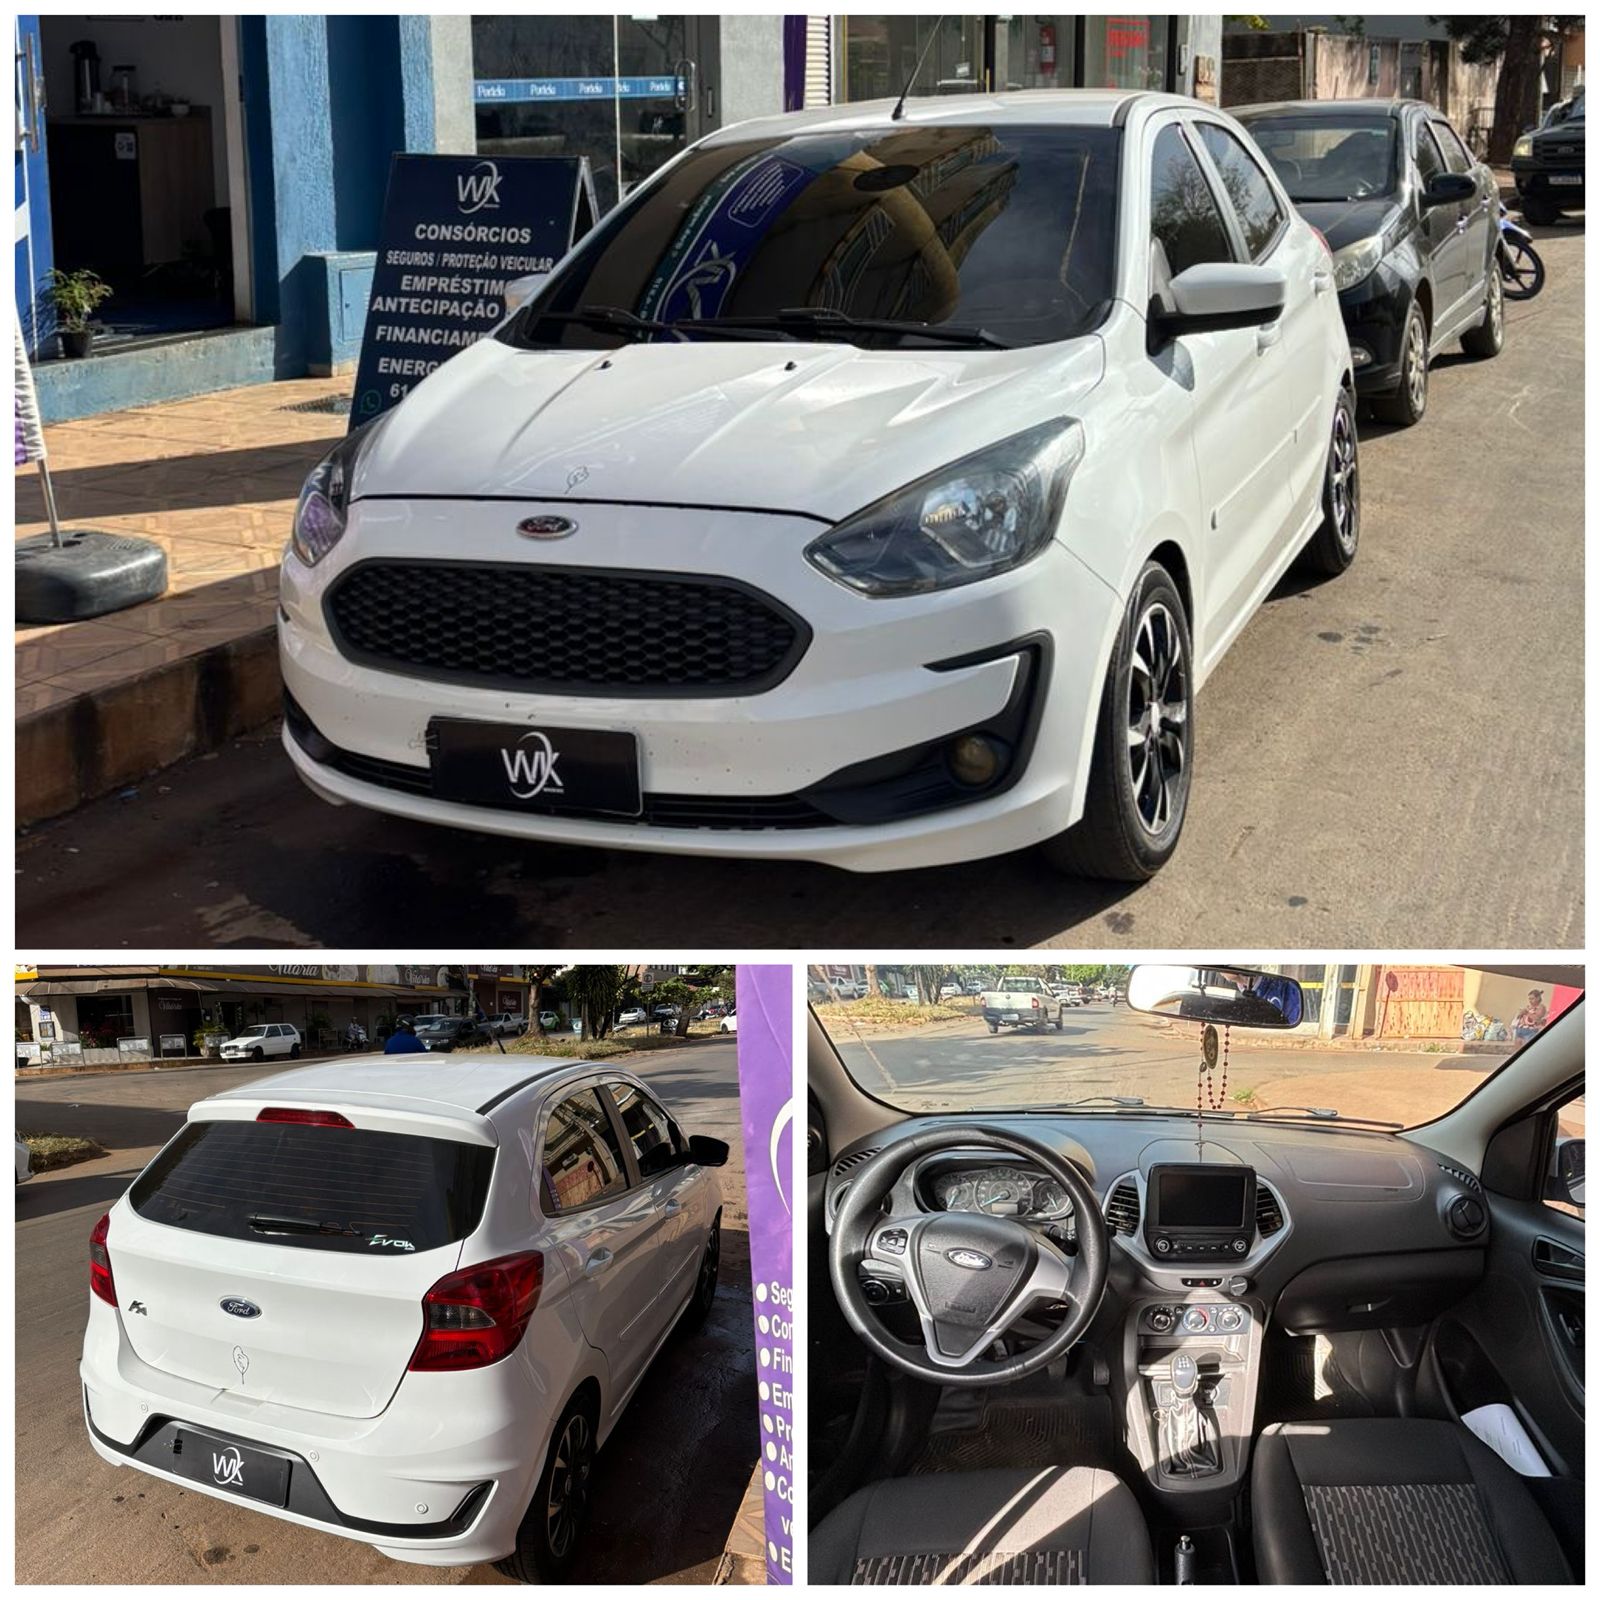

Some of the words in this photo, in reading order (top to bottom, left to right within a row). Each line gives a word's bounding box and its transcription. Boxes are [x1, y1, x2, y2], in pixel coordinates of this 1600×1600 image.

[414, 222, 532, 244] CONSÓRCIOS
[386, 250, 434, 267] SEGUROS
[442, 252, 498, 273] PROTEÇÃO
[500, 255, 554, 272] VEICULAR
[371, 296, 500, 321] ANTECIPAÇÃO
[227, 1302, 250, 1315] Ford
[776, 1415, 793, 1442] Pr
[781, 1546, 793, 1574] E
